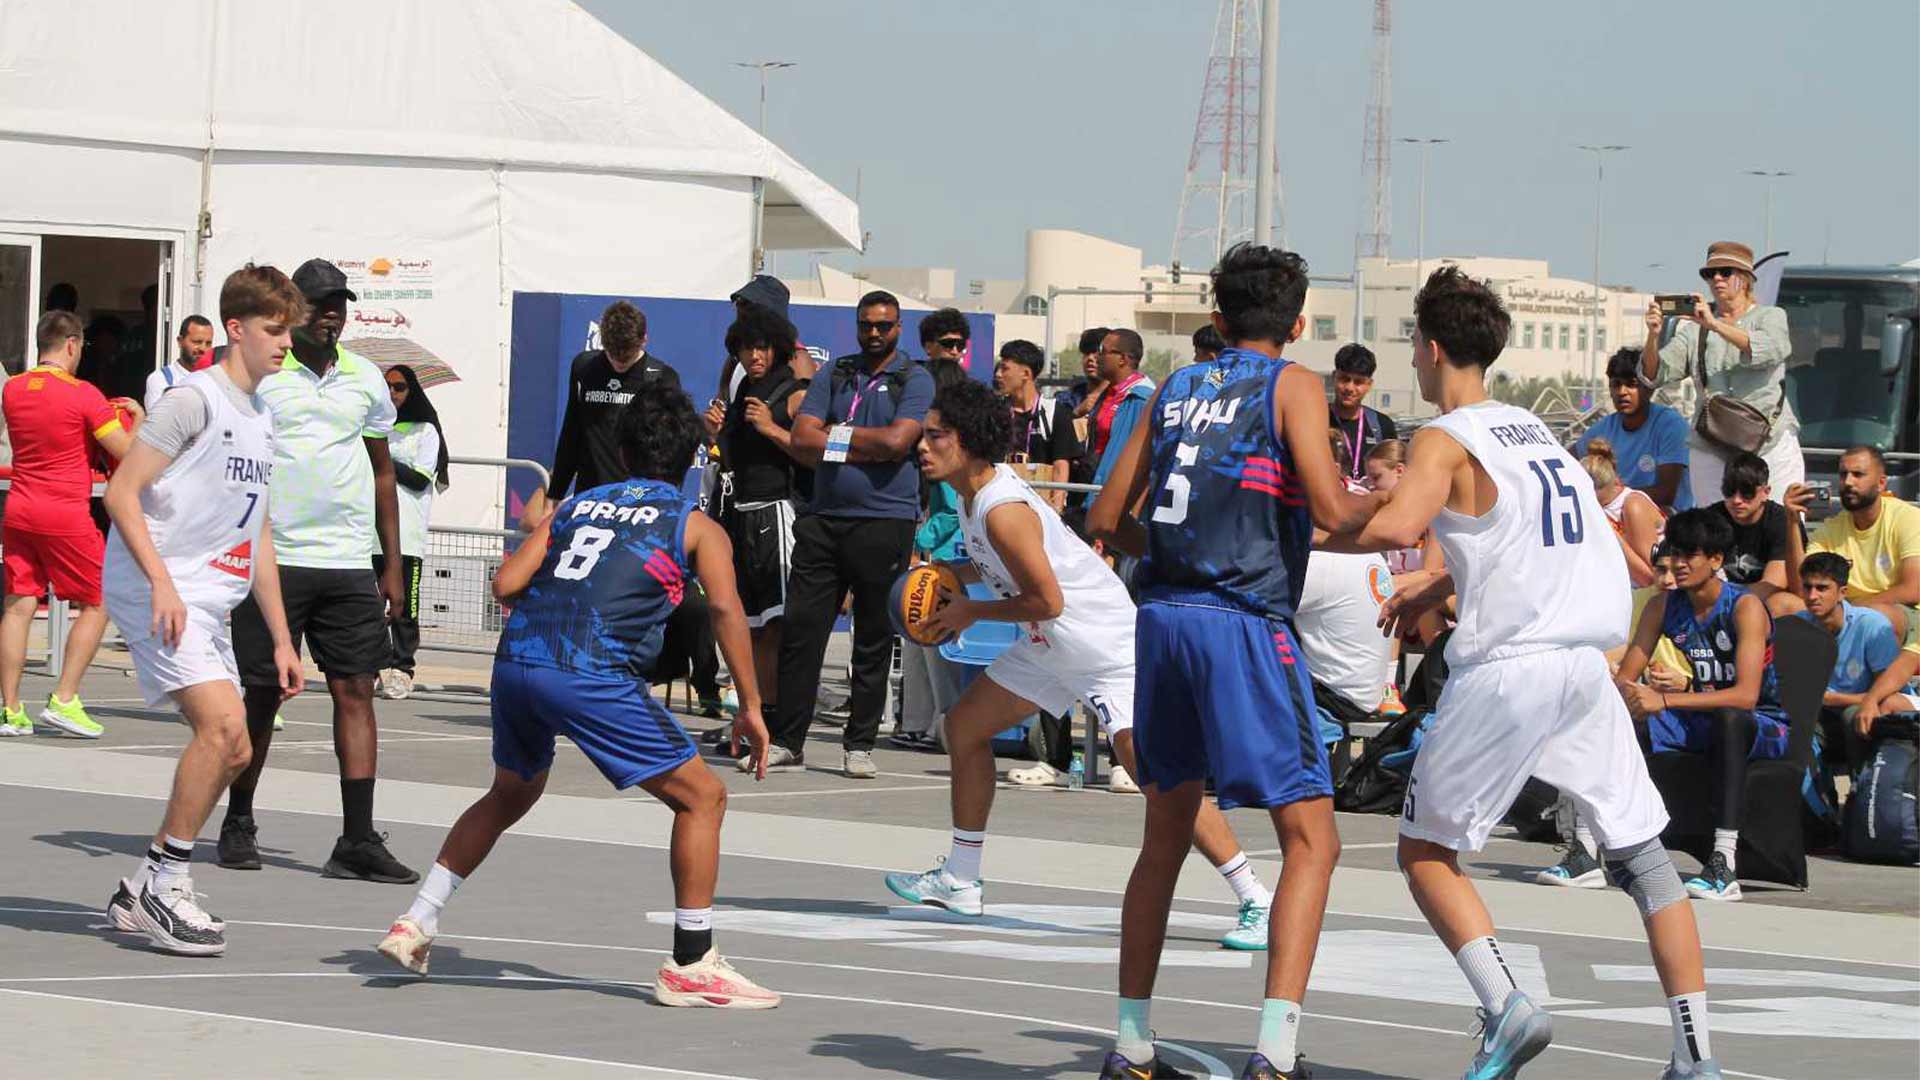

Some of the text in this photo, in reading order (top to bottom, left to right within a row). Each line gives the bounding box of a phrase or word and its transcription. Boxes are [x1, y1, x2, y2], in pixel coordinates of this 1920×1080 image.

[236, 492, 259, 529] 7
[1152, 442, 1200, 525] 5
[1527, 458, 1584, 547] 15
[553, 524, 617, 581] 8
